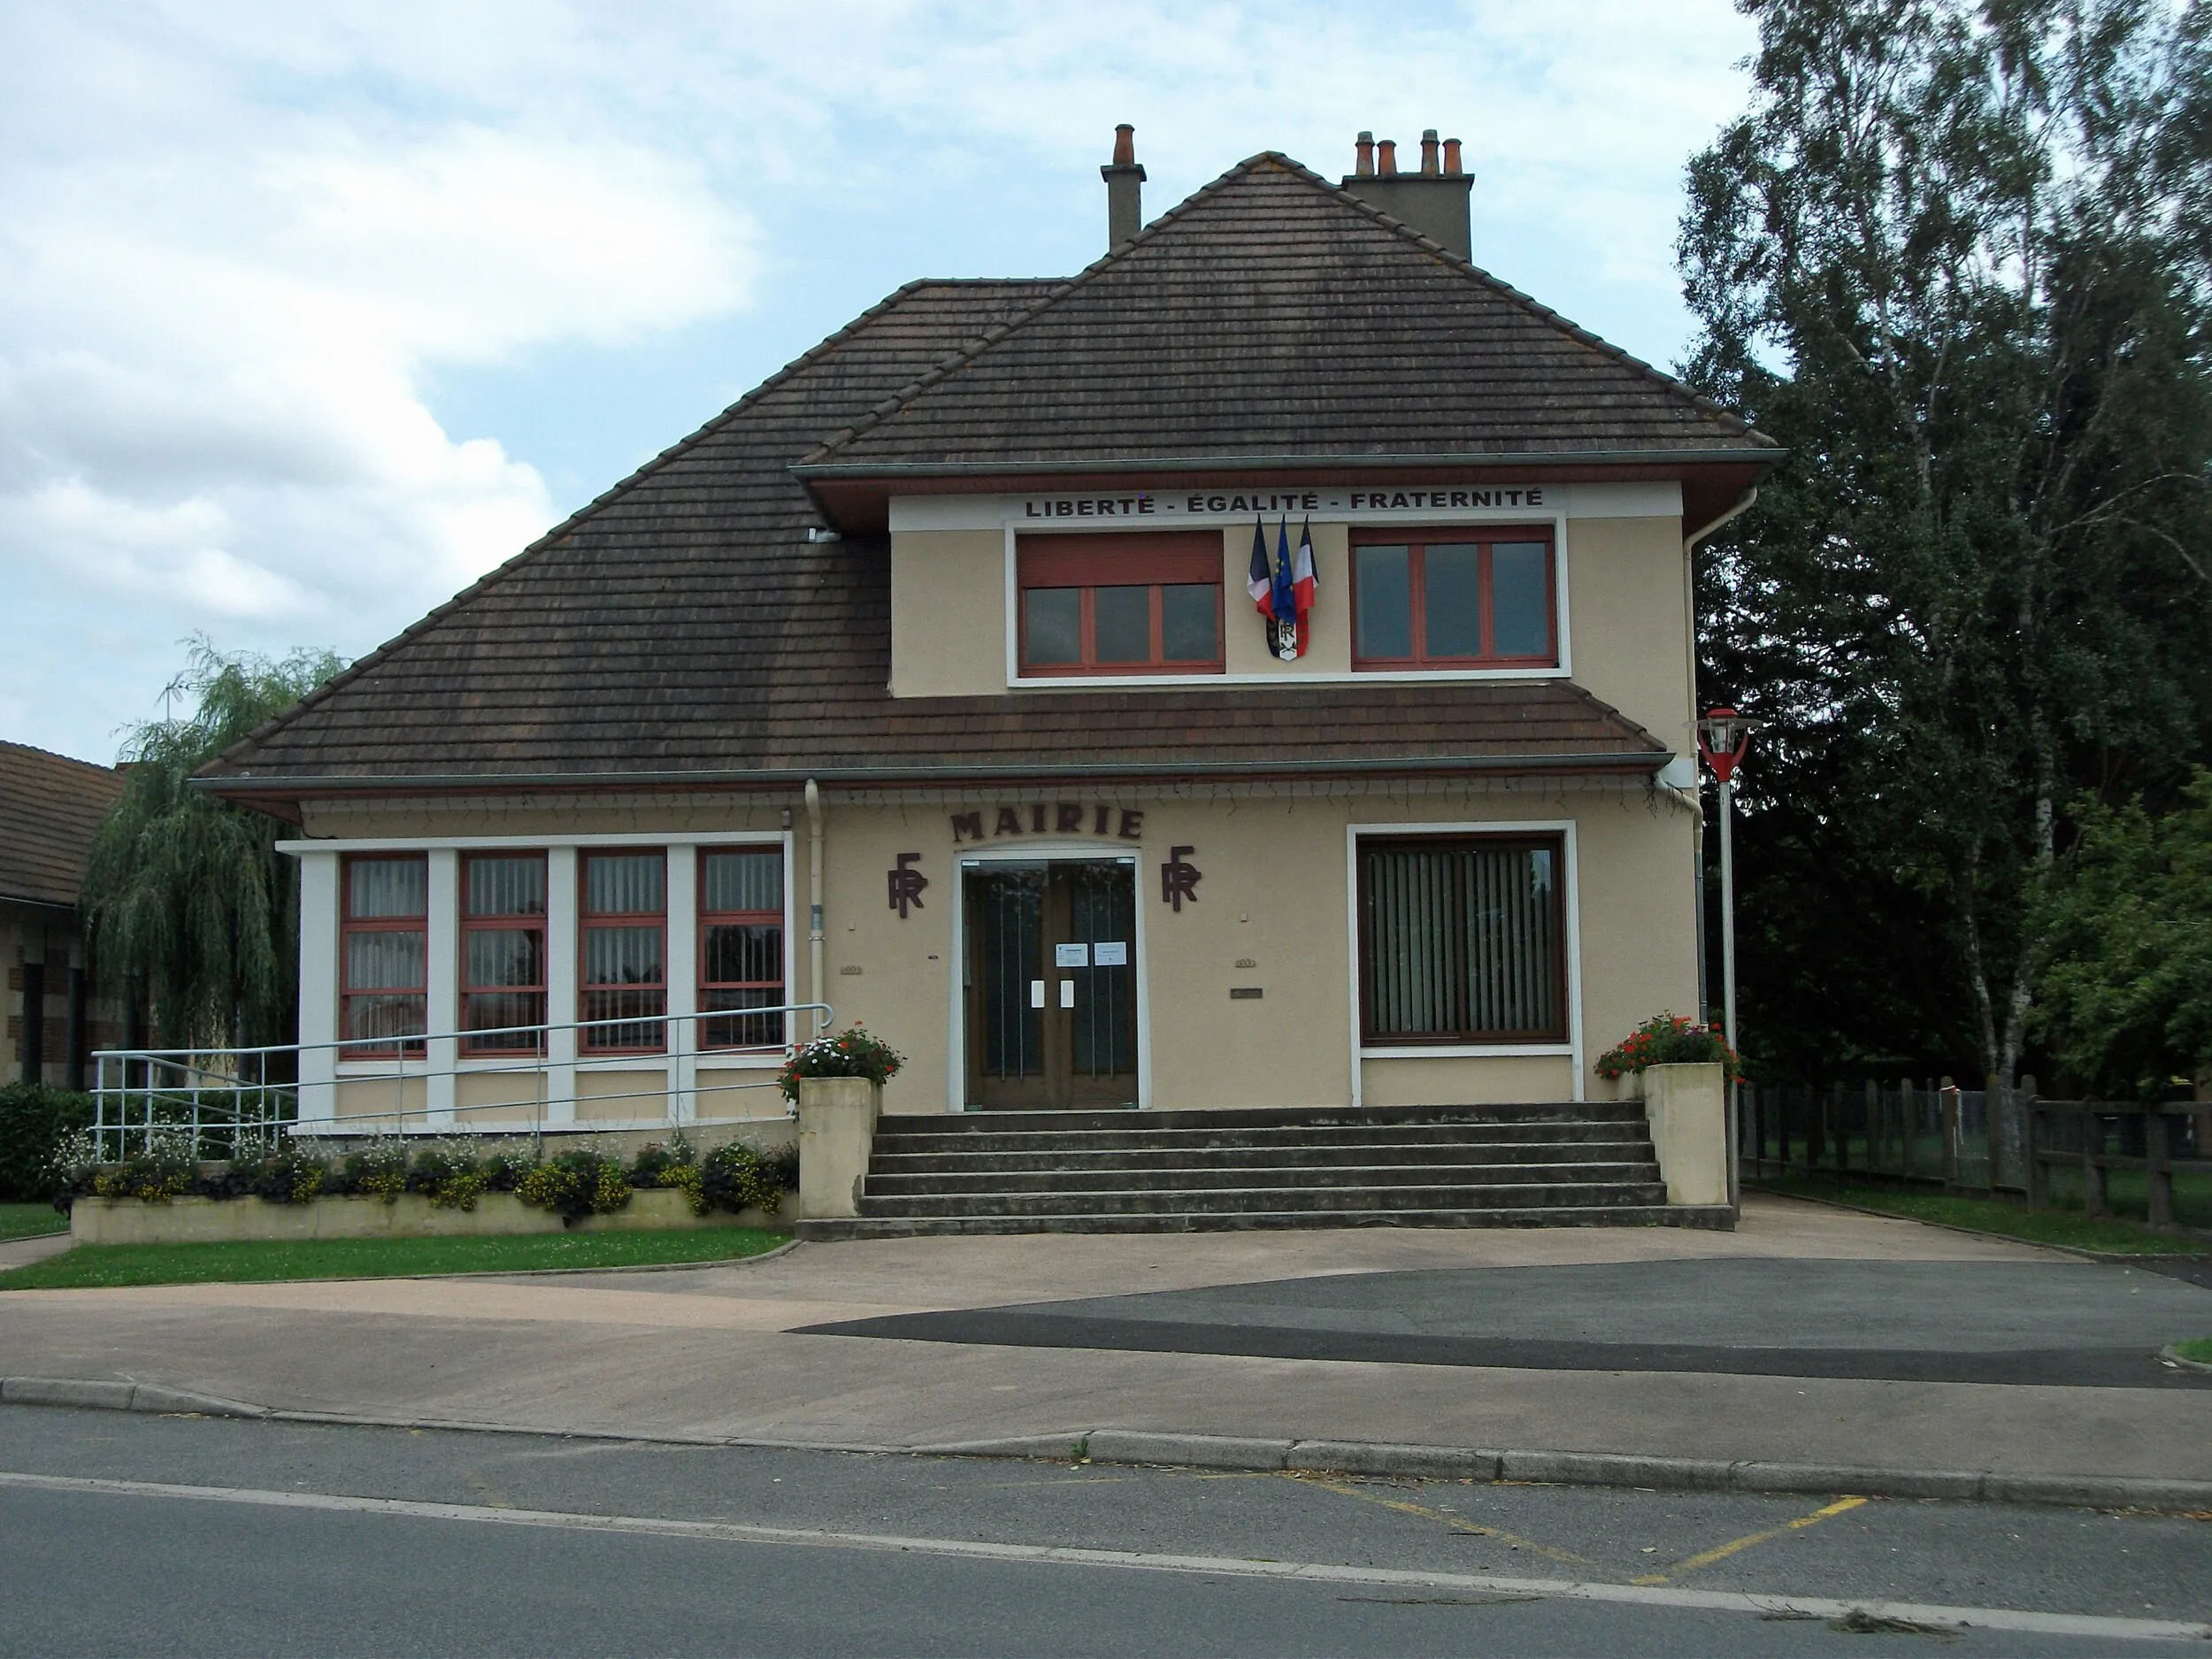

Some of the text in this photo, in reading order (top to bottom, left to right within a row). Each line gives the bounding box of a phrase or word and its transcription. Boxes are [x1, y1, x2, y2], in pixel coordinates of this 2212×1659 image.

[1026, 495, 1156, 517] LIBERTÉ
[1187, 491, 1317, 511] ÉGALITÉ
[1351, 487, 1543, 509] FRATERNITÉ
[950, 803, 1144, 842] MAIRIE
